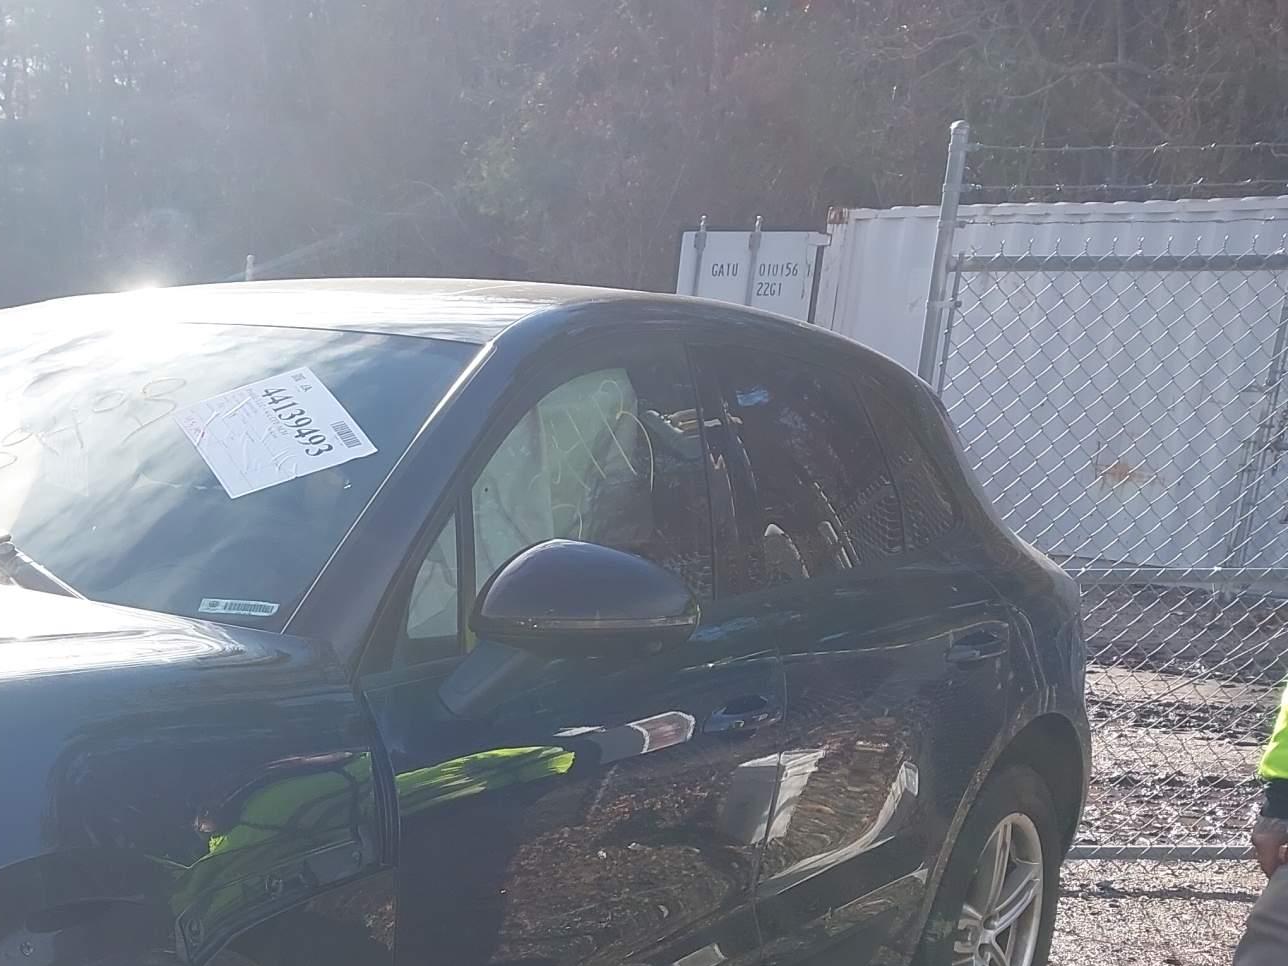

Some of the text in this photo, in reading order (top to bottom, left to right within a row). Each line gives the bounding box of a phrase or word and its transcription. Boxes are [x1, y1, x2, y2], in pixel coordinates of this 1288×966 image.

[712, 263, 739, 277] GATU
[759, 262, 798, 277] 010156
[756, 281, 782, 297] 22G1
[262, 387, 334, 457] 44139493
